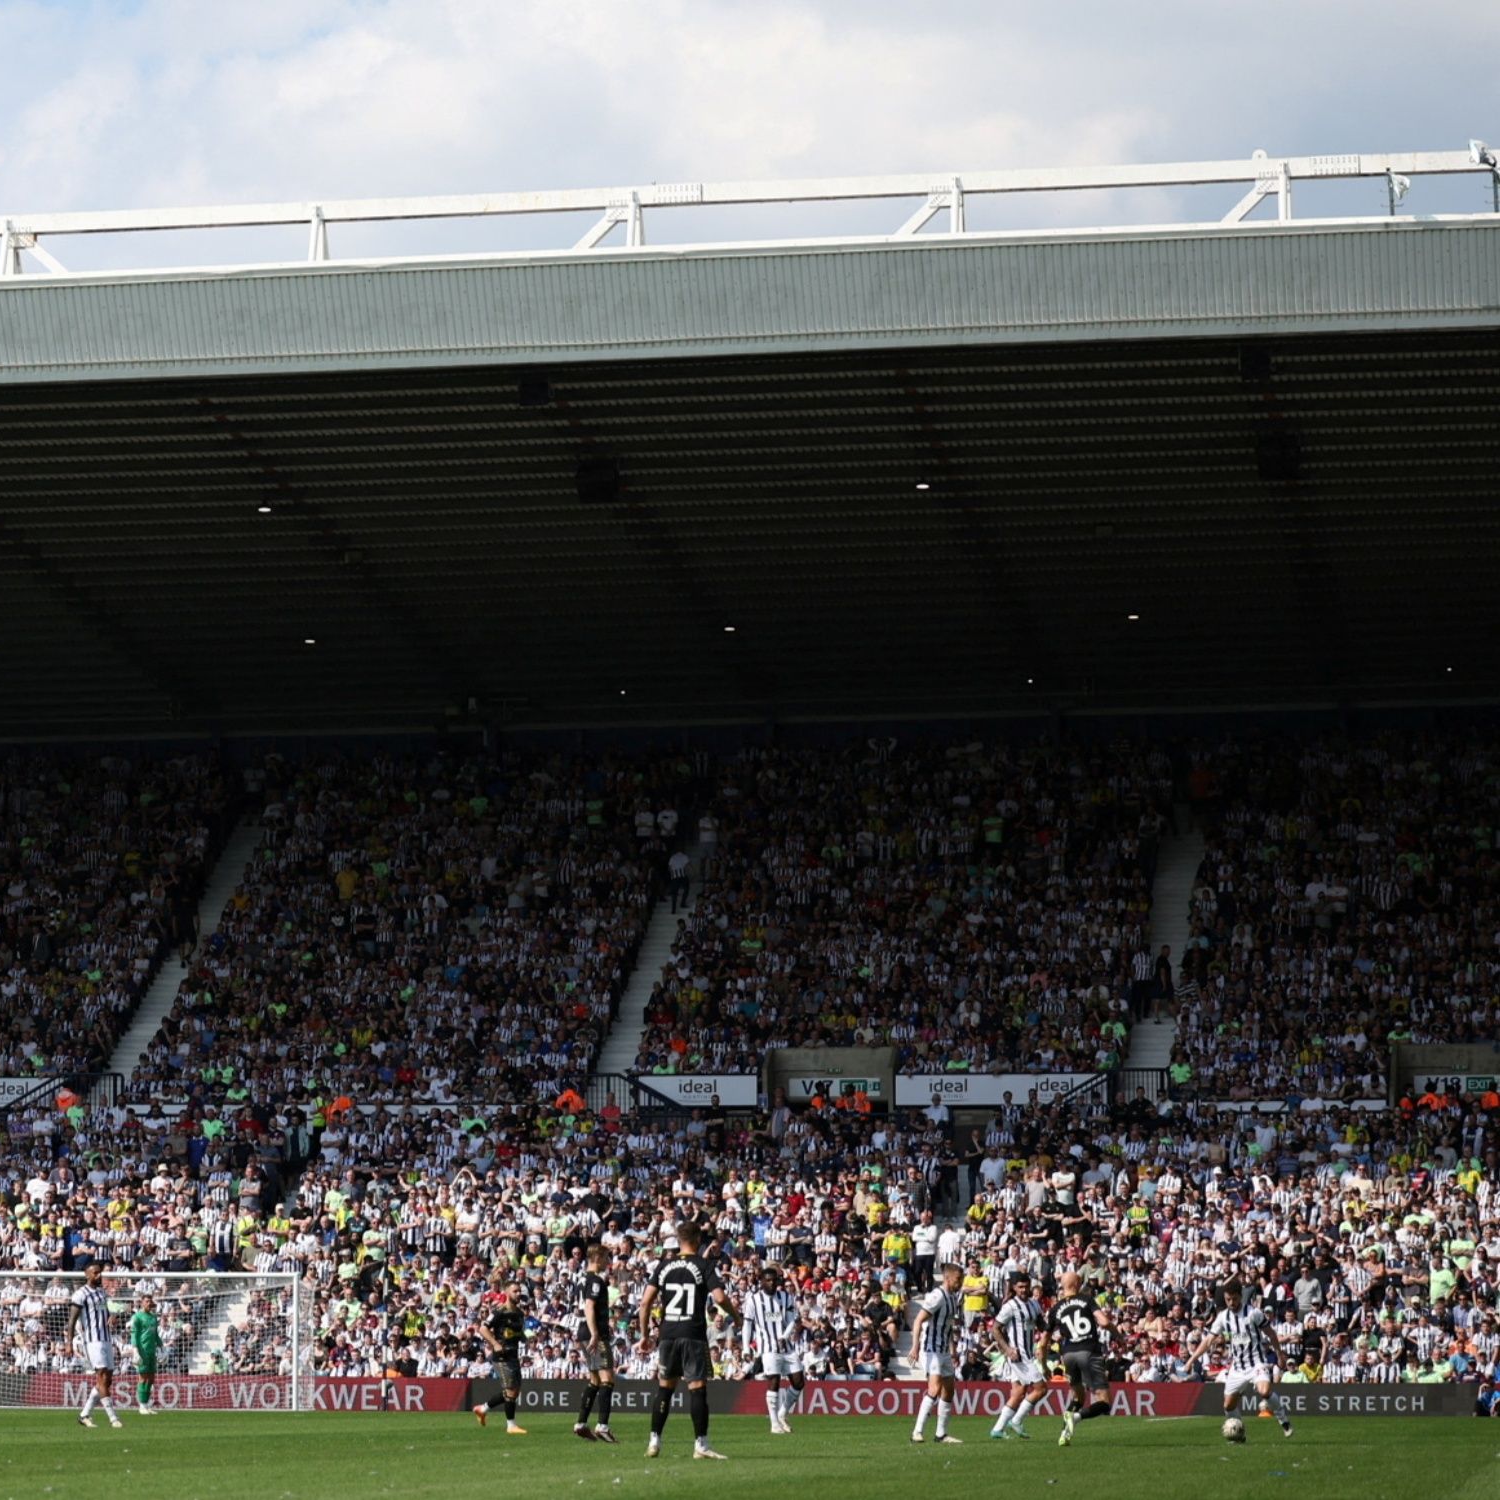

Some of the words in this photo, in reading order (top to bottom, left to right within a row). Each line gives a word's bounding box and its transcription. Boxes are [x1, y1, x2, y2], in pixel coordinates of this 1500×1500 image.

[679, 1079, 717, 1093] ideal
[929, 1078, 968, 1093] ideal
[1035, 1077, 1074, 1092] ideal
[665, 1283, 695, 1315] 21
[1060, 1309, 1092, 1340] 16
[1242, 1396, 1307, 1412] MRE
[1319, 1396, 1425, 1413] STRETCH
